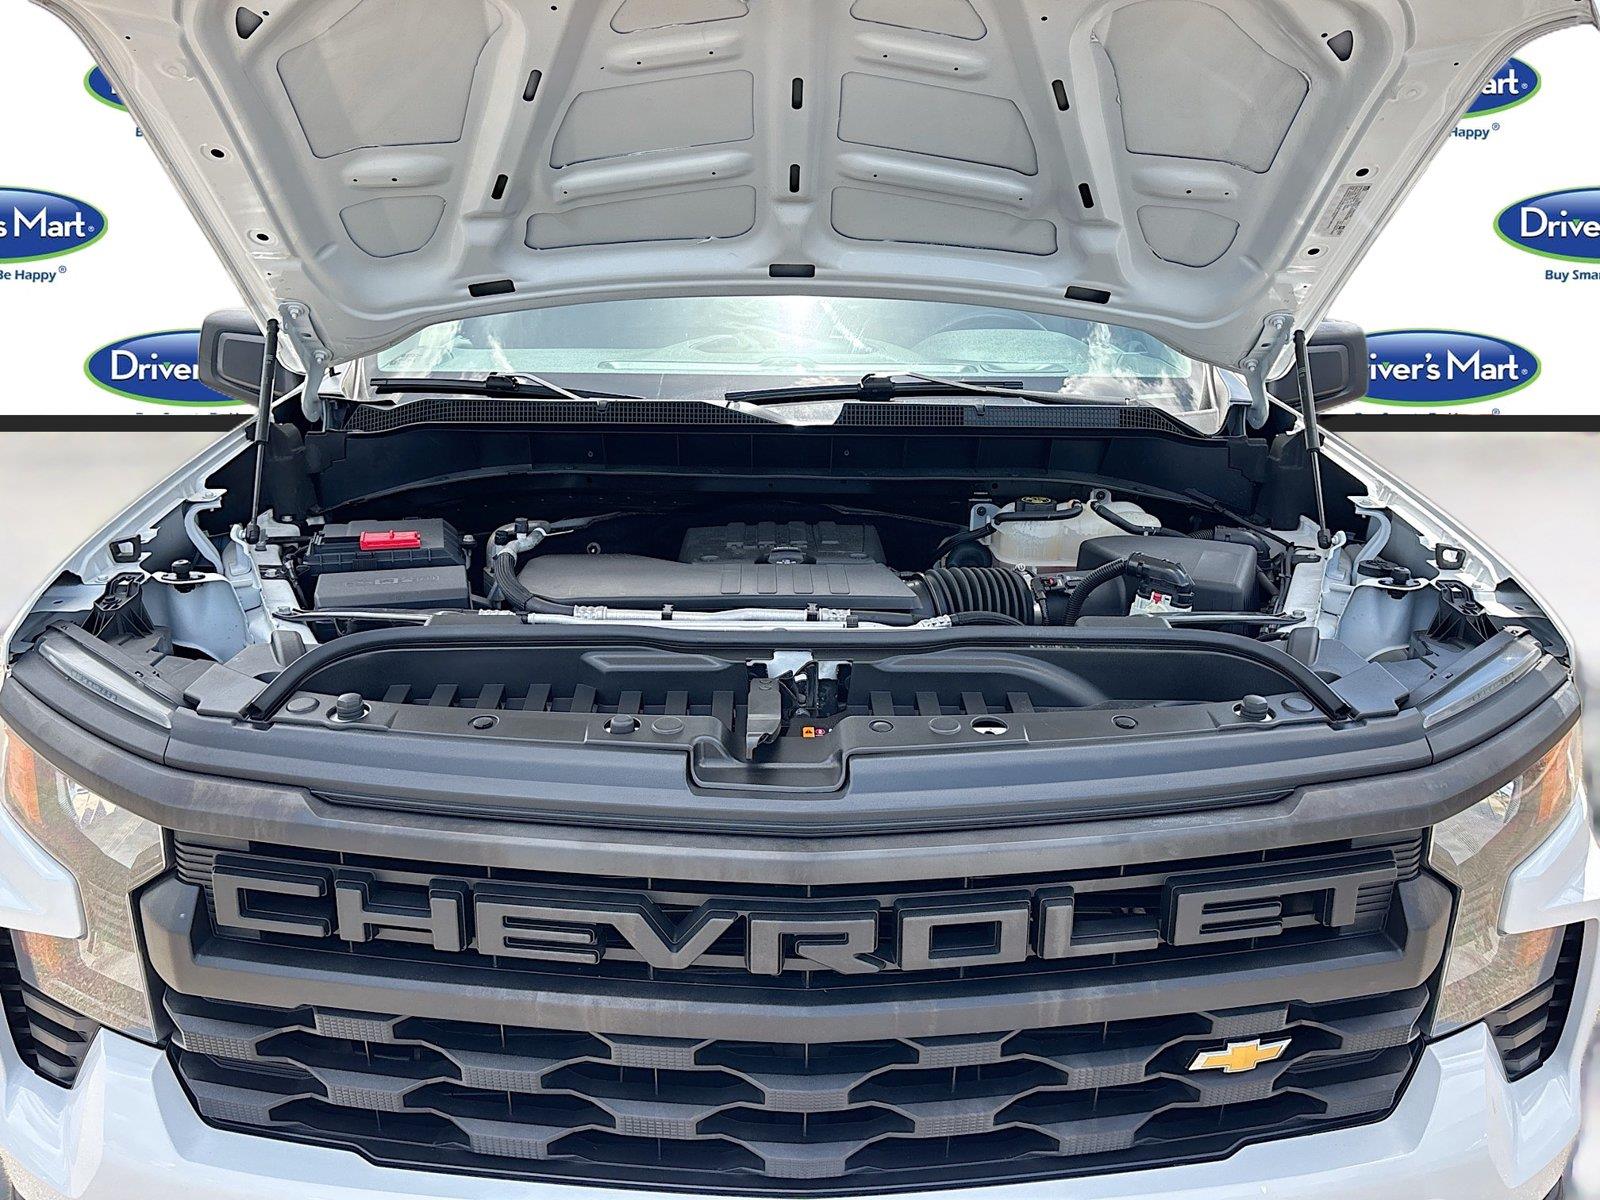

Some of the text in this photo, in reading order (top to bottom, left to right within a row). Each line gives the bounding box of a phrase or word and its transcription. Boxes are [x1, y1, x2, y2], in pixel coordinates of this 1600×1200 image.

[13, 206, 86, 238] Mart
[15, 269, 57, 283] Happy
[1545, 269, 1569, 283] Buy
[1367, 349, 1519, 381] iver's Mart
[212, 851, 1398, 976] CHEVROLET
